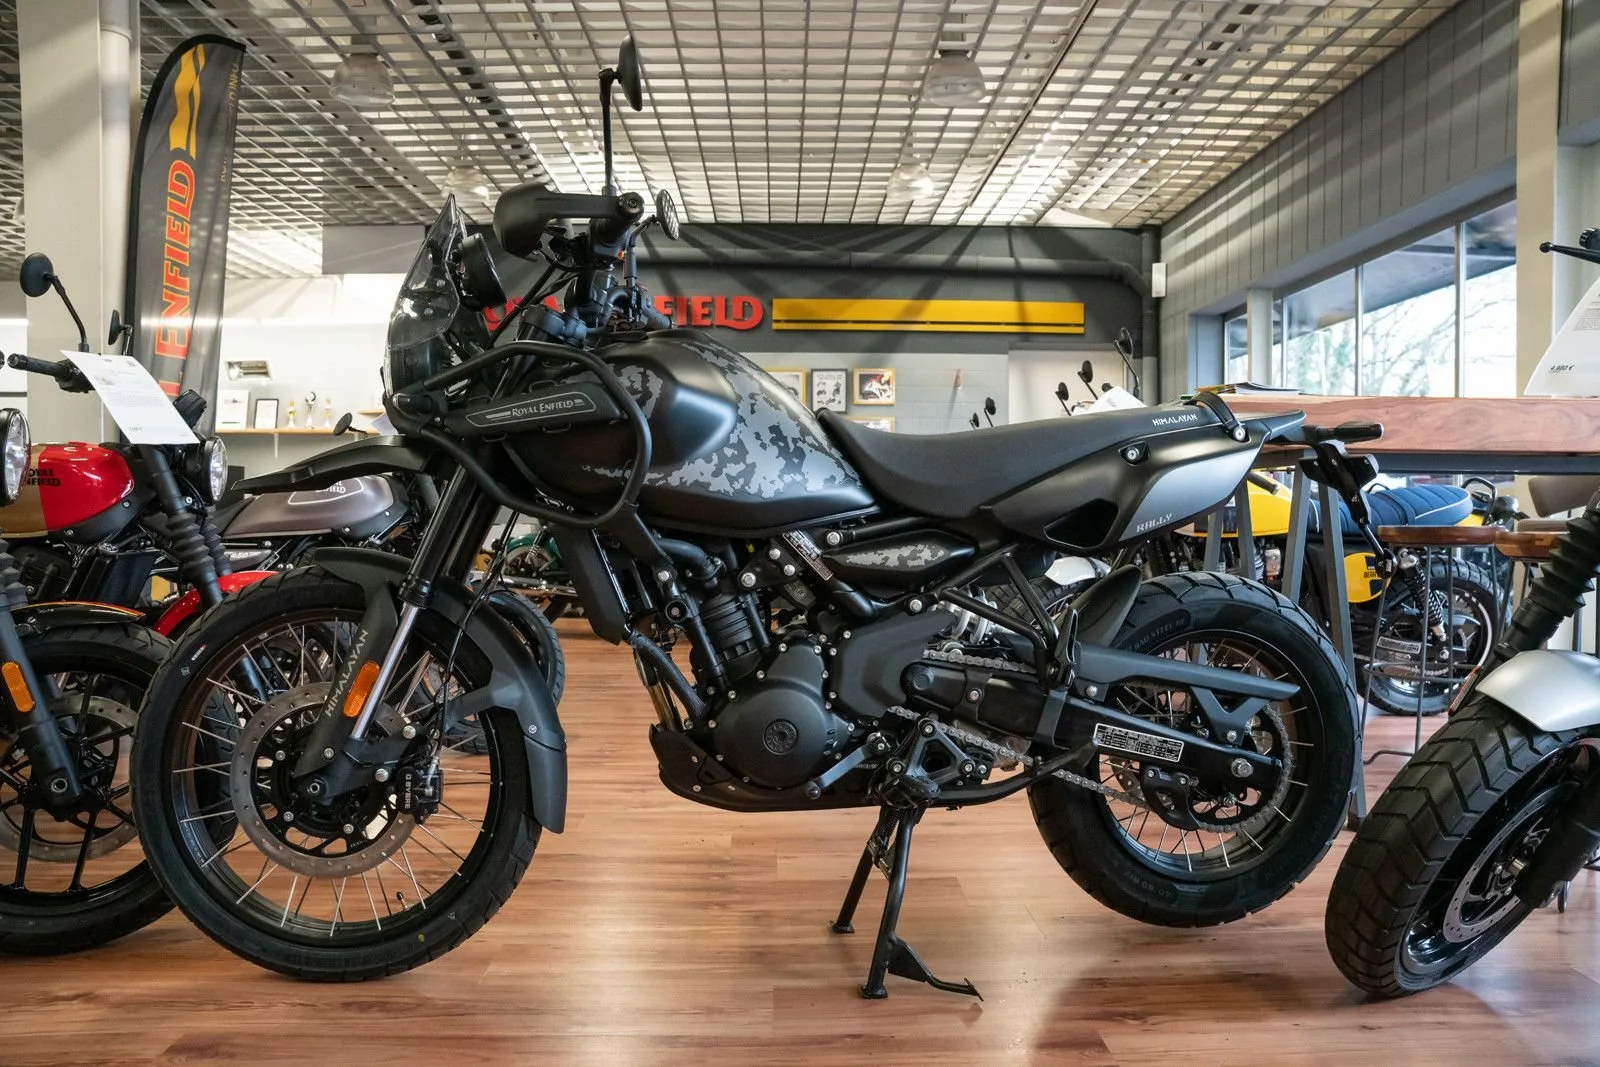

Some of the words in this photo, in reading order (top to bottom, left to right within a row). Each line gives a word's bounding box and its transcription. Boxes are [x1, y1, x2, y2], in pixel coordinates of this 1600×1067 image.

[155, 160, 195, 360] ENFIELD
[653, 295, 764, 331] FIELD
[511, 405, 539, 418] ROYAL
[539, 399, 575, 414] ENFIELD
[1152, 413, 1197, 426] HIMALAYAN
[28, 468, 54, 477] OYAL
[1136, 512, 1172, 532] RALLY
[324, 629, 369, 717] HIMALAYAN
